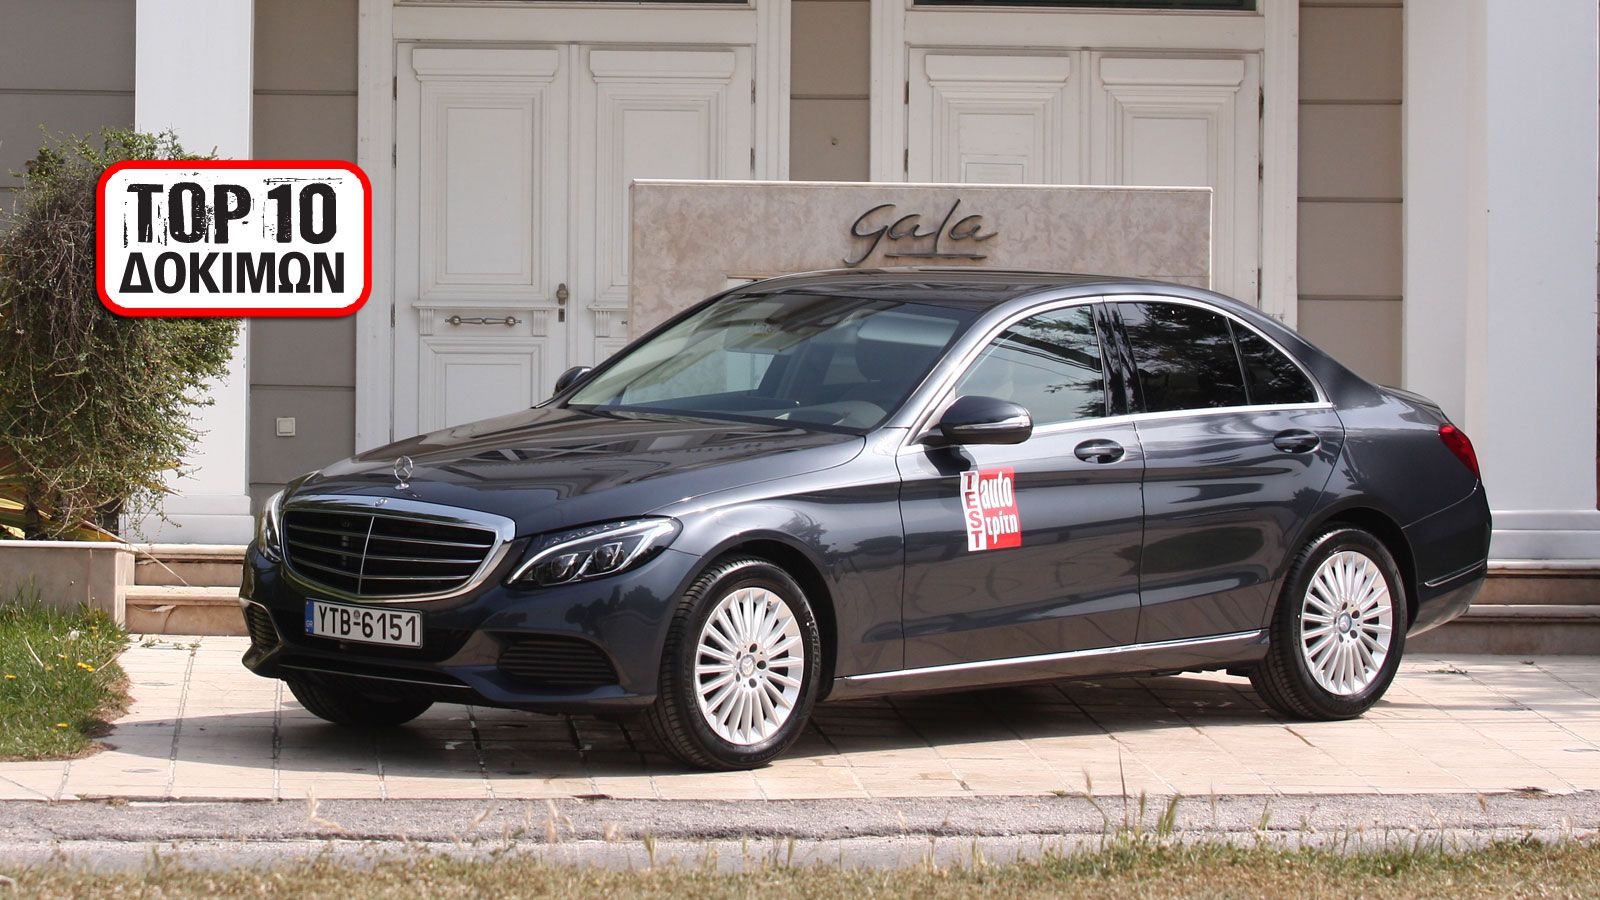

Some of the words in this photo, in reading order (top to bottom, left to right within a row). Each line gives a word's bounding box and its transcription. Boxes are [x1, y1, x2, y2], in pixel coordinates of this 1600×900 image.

[843, 199, 999, 267] gala
[963, 472, 983, 548] TEST
[980, 470, 1014, 510] auto
